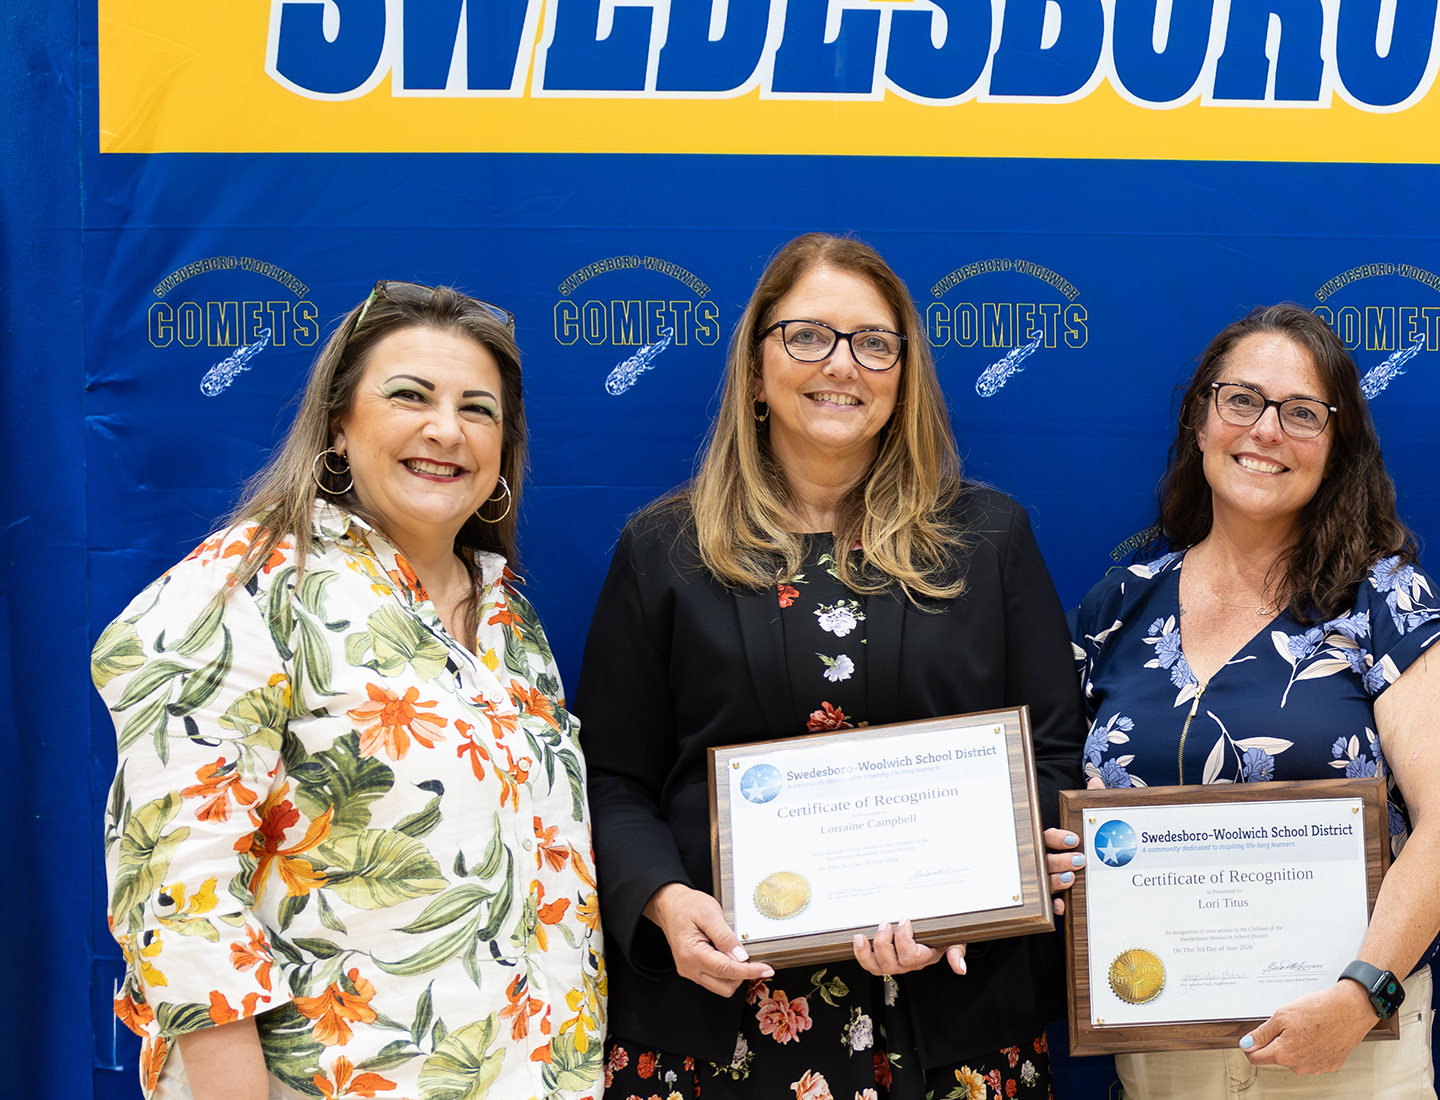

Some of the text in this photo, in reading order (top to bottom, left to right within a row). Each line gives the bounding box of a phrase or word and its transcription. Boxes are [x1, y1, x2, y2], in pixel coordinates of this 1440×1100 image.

[153, 256, 310, 298] SWEDESBORO-WOOLWICH
[558, 255, 711, 298] SWEDESBORO-WOOLWICH
[930, 258, 1081, 302] SWEDESBORO-WOOLWICH
[148, 301, 319, 348] COMETS
[554, 299, 720, 346] COMETS
[926, 302, 1088, 349] COMETS
[786, 745, 997, 781] Swedesboro-Woolwich School District
[777, 801, 851, 818] Certificate
[854, 795, 869, 809] of
[874, 787, 958, 806] Recognition
[820, 822, 864, 834] Lorraine
[866, 813, 917, 828] Campbell
[1141, 823, 1353, 843] Swedesboro-Woolwich School District
[1147, 845, 1181, 853] community
[1181, 843, 1211, 852] dedicated
[1218, 843, 1245, 851] inspiring
[1245, 841, 1270, 850] life-long
[1131, 867, 1313, 887] Certificate of Recognition
[1198, 897, 1249, 909] Lori Titus
[1205, 945, 1217, 953] Day
